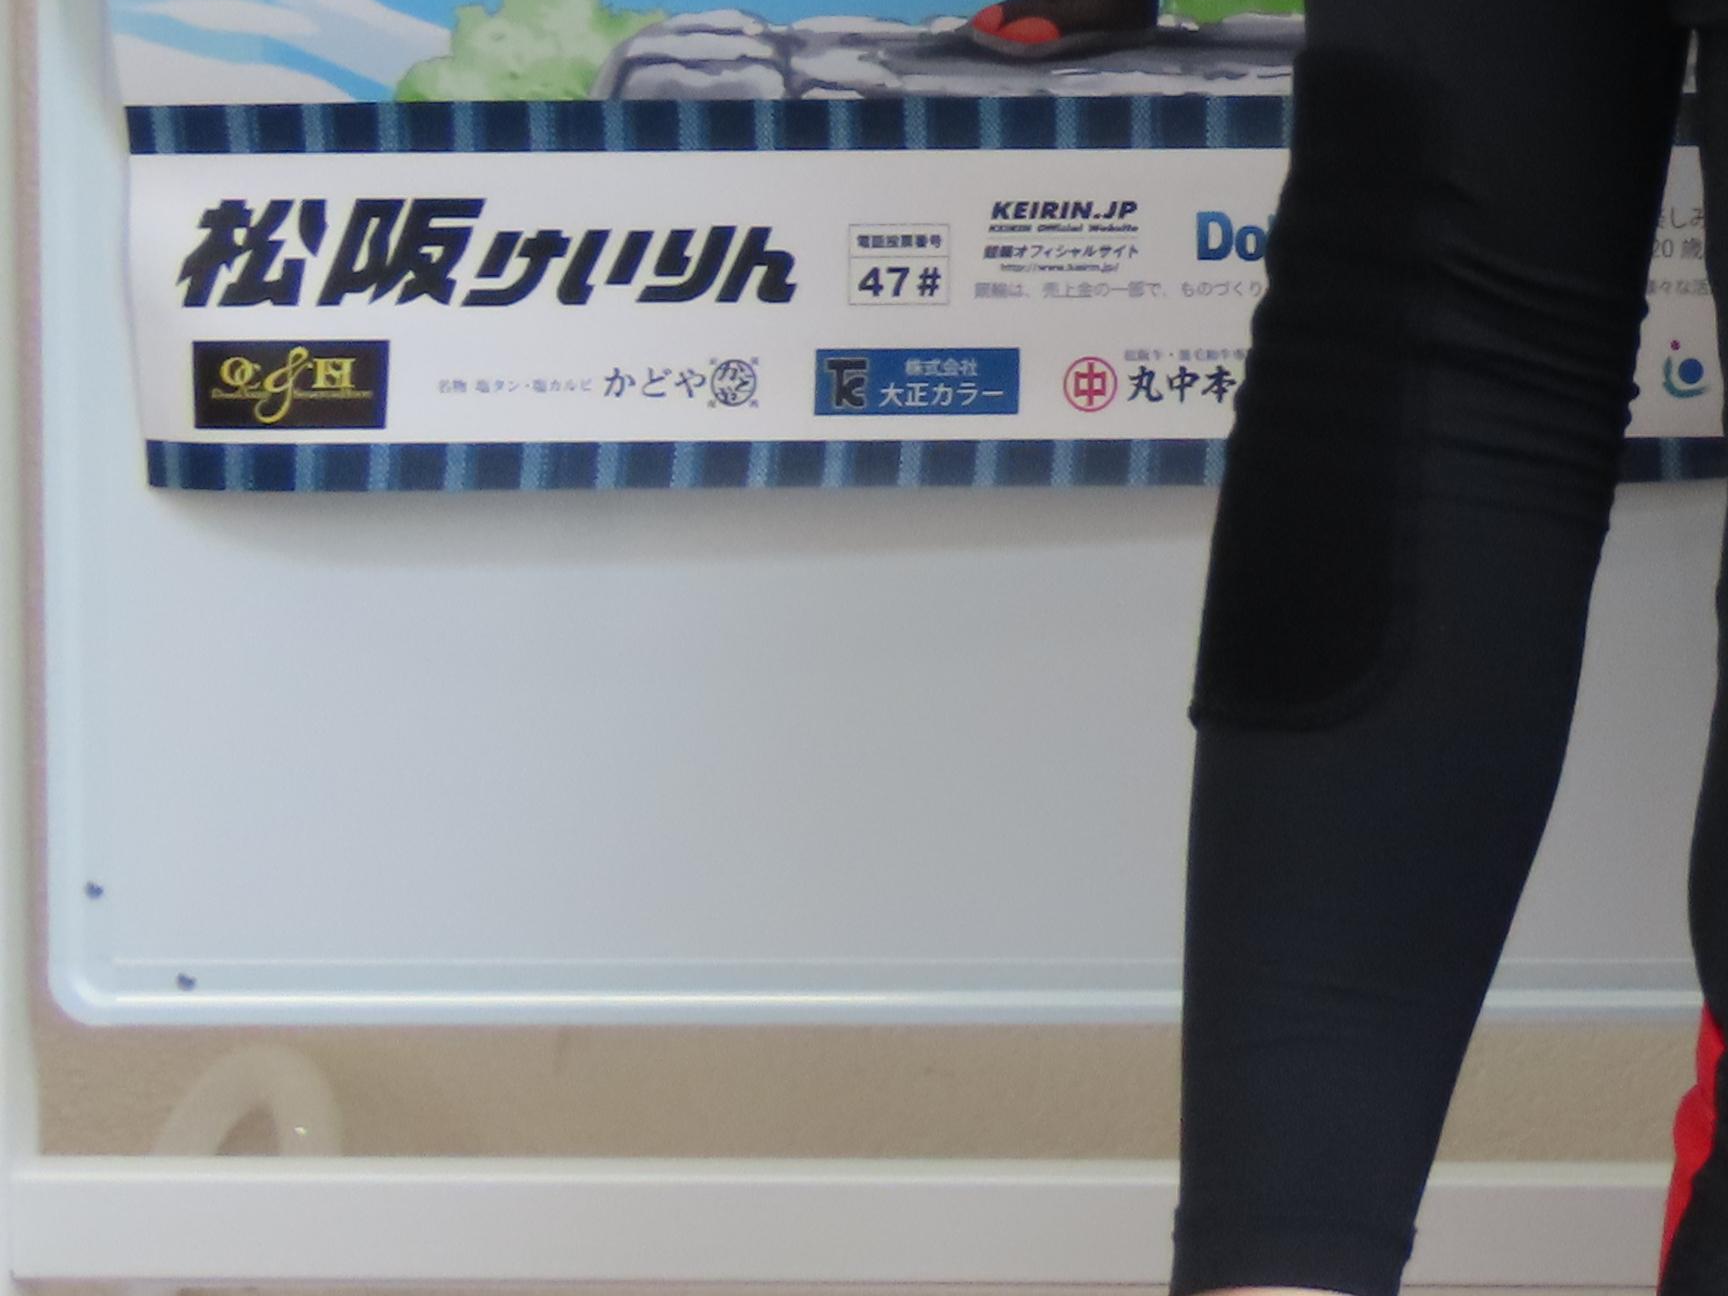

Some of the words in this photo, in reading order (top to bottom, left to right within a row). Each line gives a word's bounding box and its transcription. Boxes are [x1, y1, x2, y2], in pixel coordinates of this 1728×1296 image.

[990, 200, 1138, 220] KEIRIN.JP
[174, 197, 797, 309] 松阪けいりん
[603, 366, 707, 398] かどや
[878, 381, 1004, 408] 大正カラー
